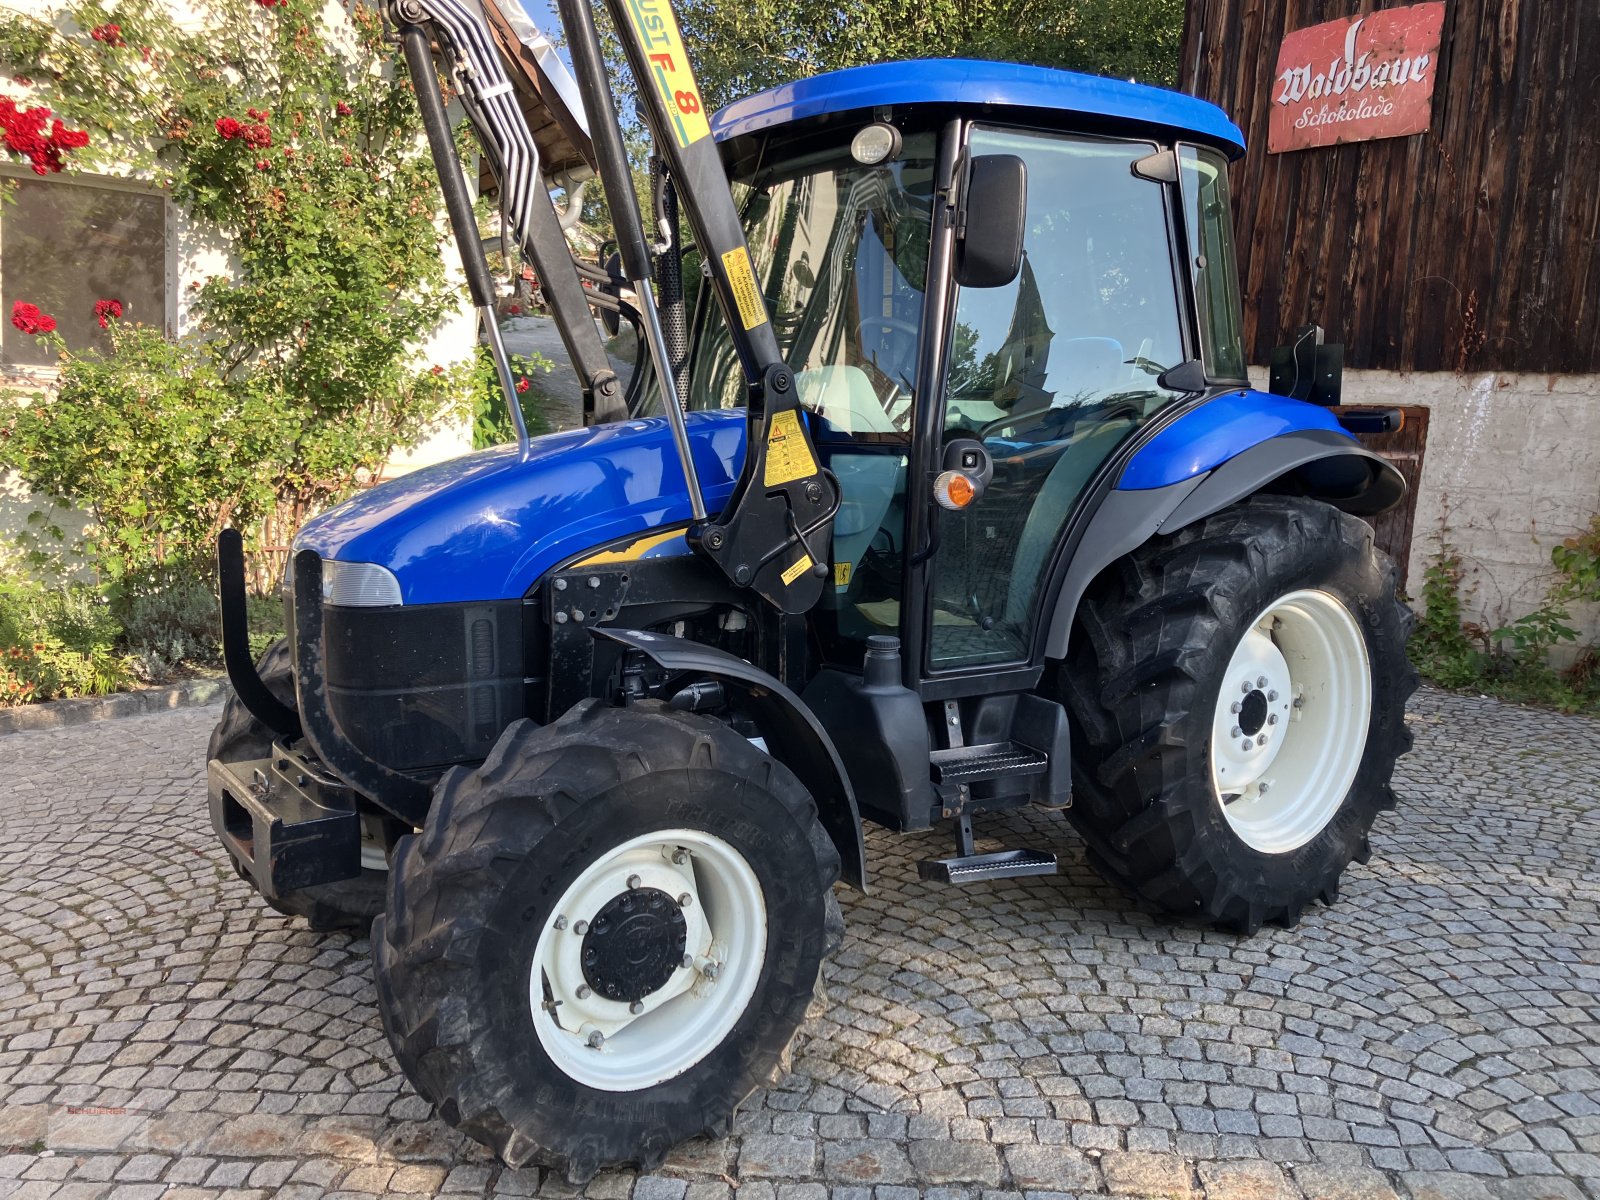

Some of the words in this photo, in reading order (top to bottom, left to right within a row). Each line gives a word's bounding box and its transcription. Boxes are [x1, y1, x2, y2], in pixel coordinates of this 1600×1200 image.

[649, 53, 676, 73] F
[674, 89, 700, 115] 8
[1277, 18, 1430, 107] Waldbaur
[1294, 95, 1394, 129] Schokolade
